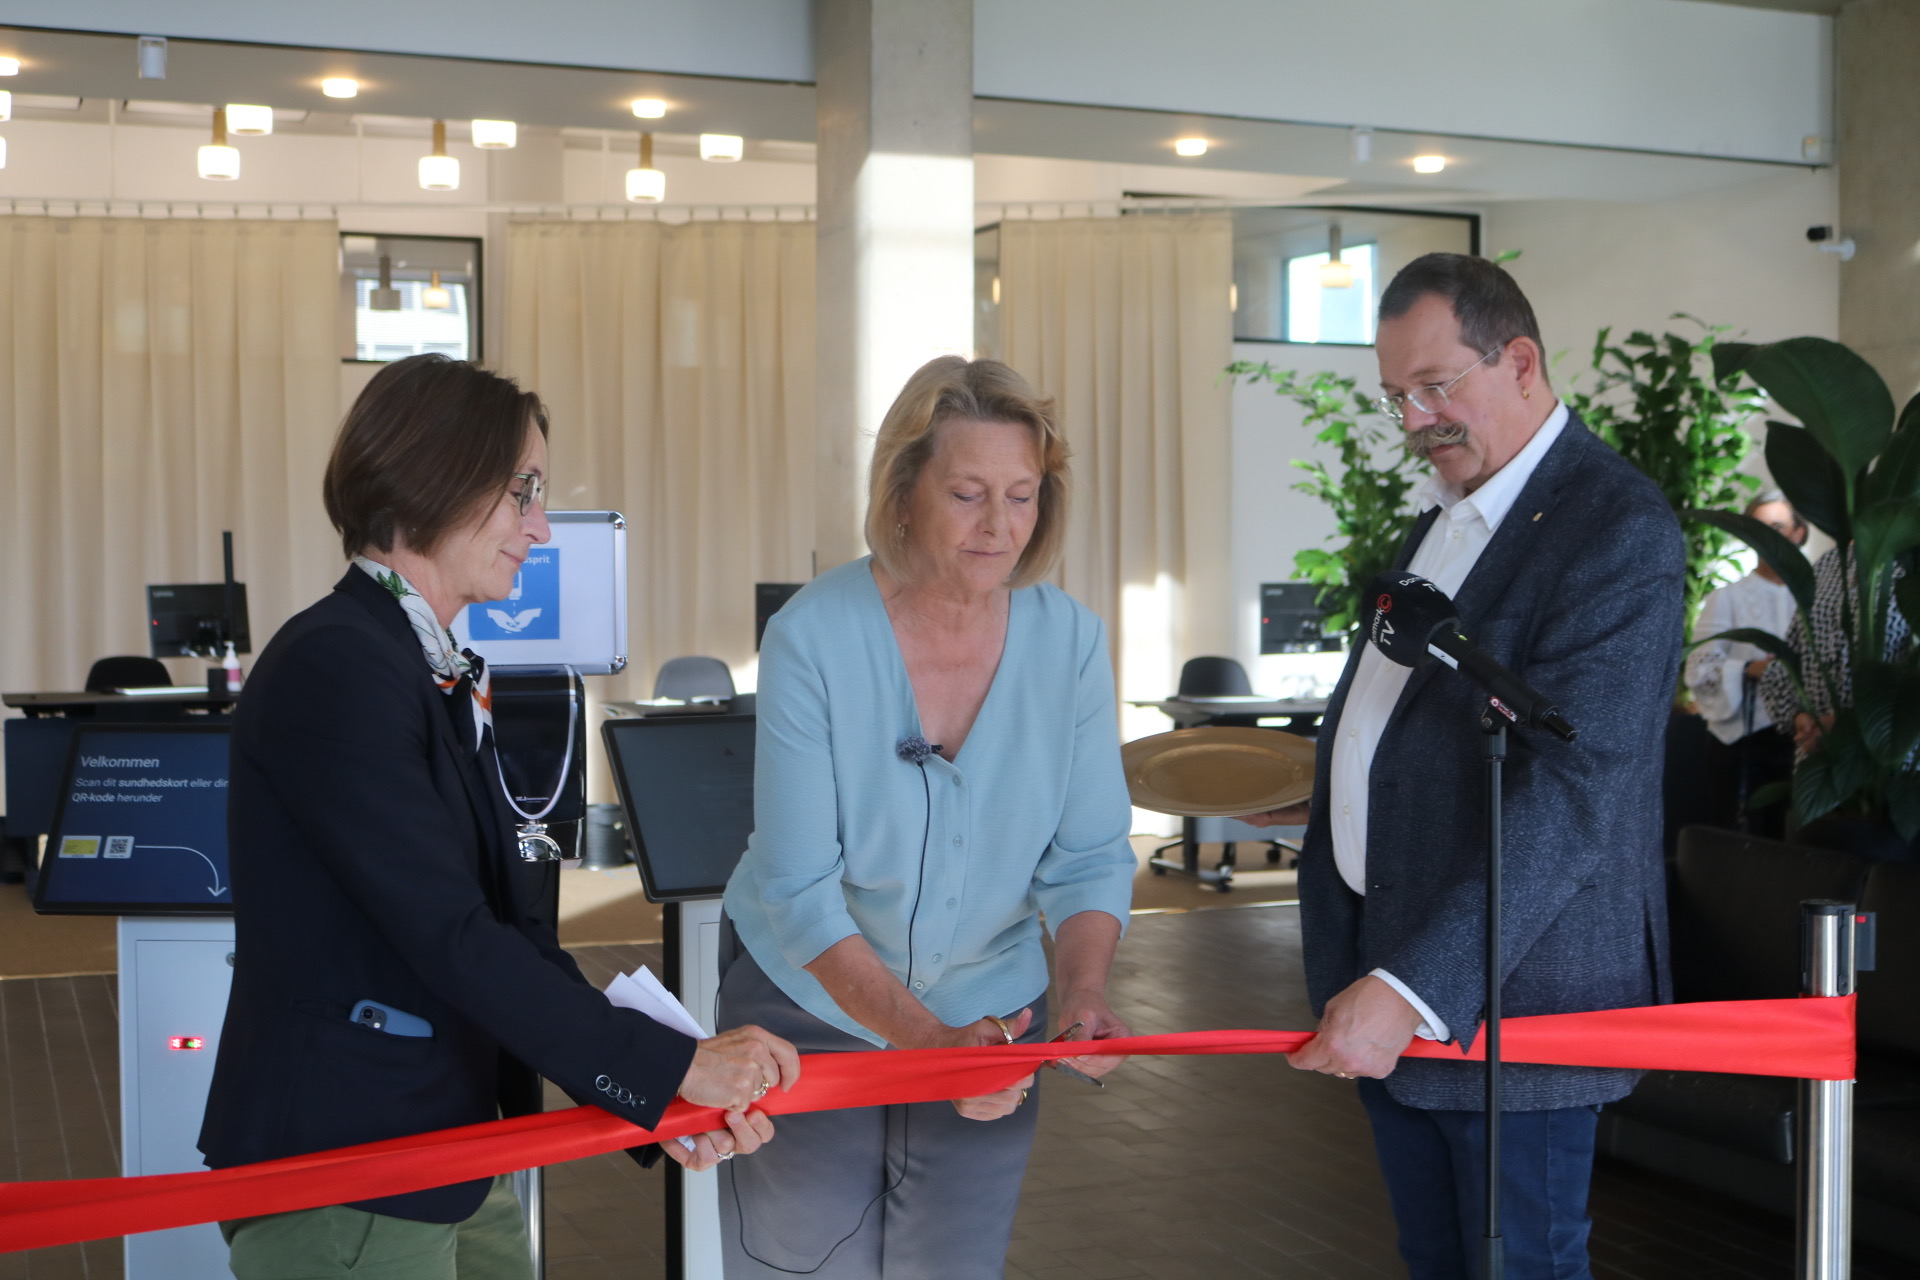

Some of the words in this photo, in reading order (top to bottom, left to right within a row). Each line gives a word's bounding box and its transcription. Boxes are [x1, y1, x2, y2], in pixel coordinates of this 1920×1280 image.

[1379, 619, 1395, 646] TV
[80, 755, 160, 768] Velkommen
[75, 778, 101, 788] Scan
[103, 778, 117, 788] dit
[118, 778, 188, 788] sundhedskort
[190, 778, 212, 788] eller
[72, 793, 115, 803] QR-kode
[117, 793, 163, 803] herunder
